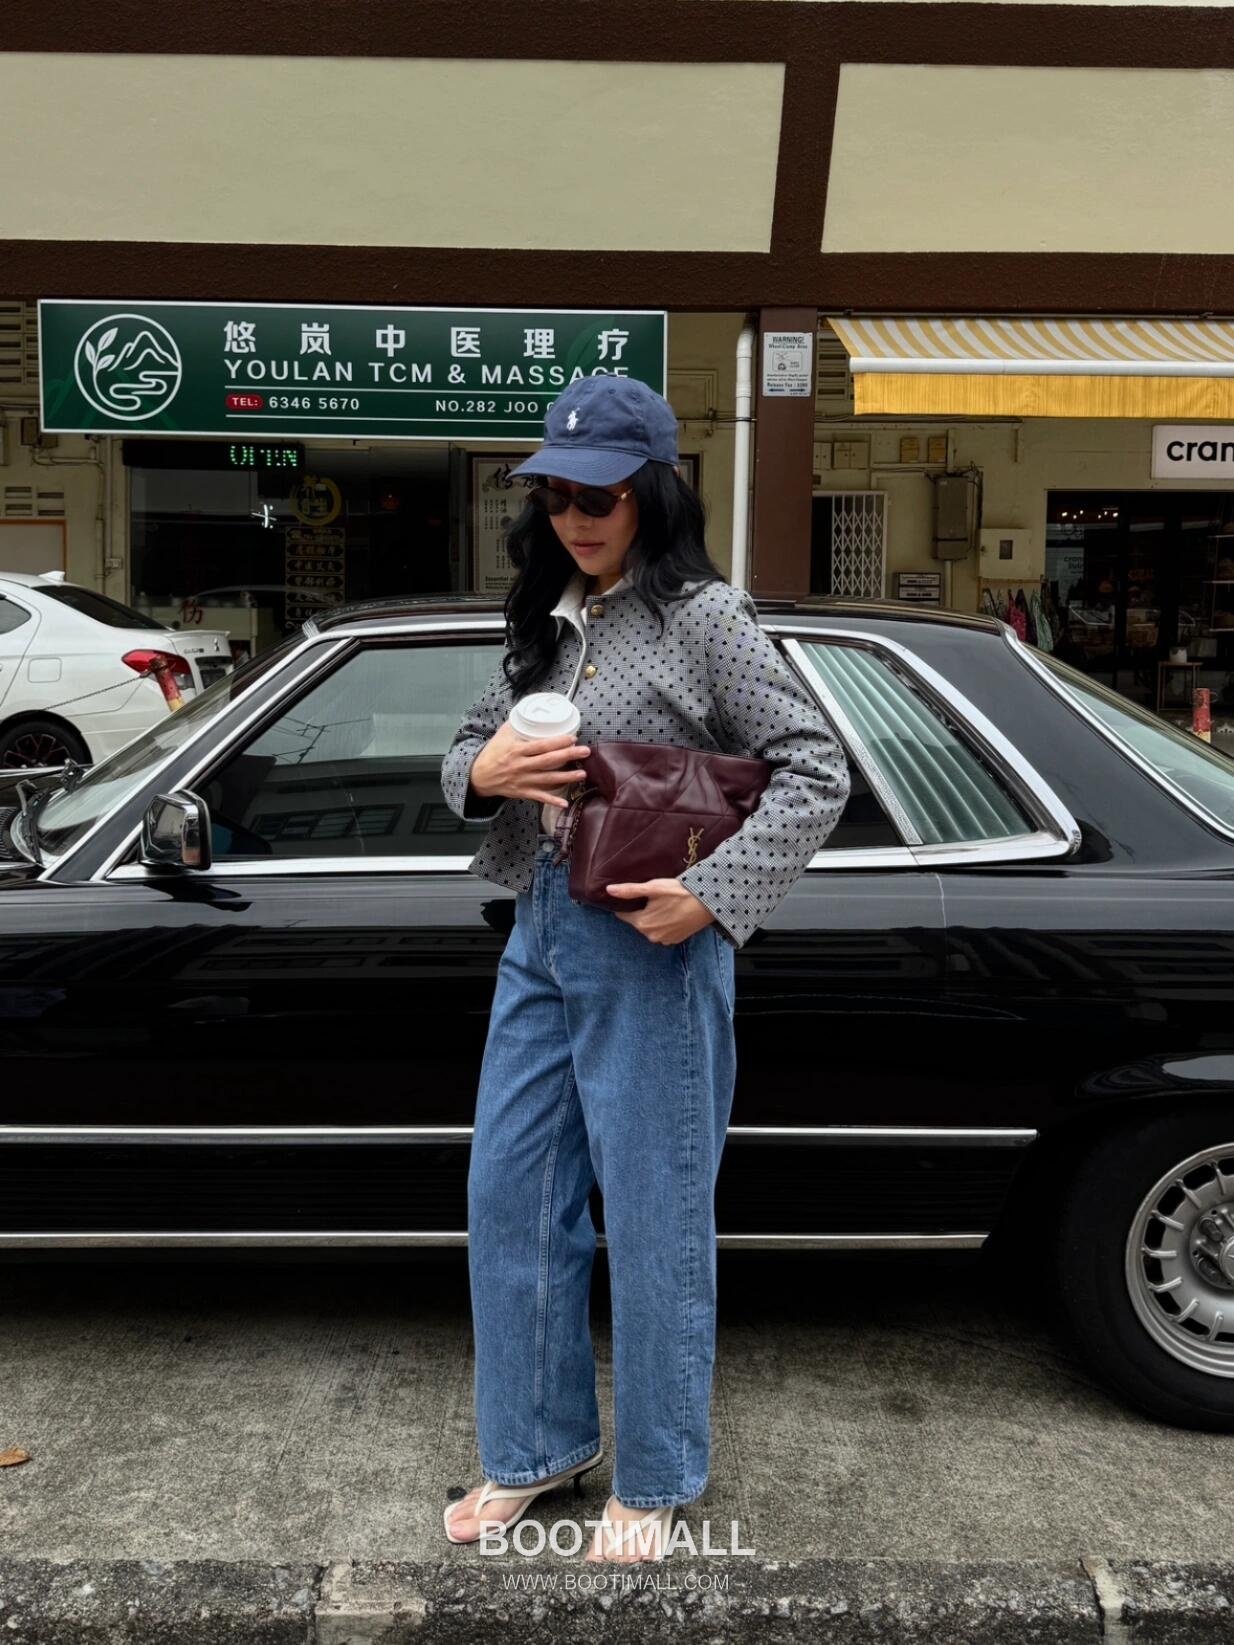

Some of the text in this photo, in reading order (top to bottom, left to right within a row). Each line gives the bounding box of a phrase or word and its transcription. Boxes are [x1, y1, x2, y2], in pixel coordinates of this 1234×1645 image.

[224, 321, 629, 360] 悠岚中医理疗
[772, 336, 805, 344] WARNING!
[224, 359, 353, 381] YOULAN
[368, 362, 432, 383] TCM
[447, 364, 466, 384] &
[232, 396, 360, 410] TEL: 6346 5670
[435, 400, 496, 413] NO.282
[504, 401, 539, 413] JOO
[1167, 441, 1234, 462] cran
